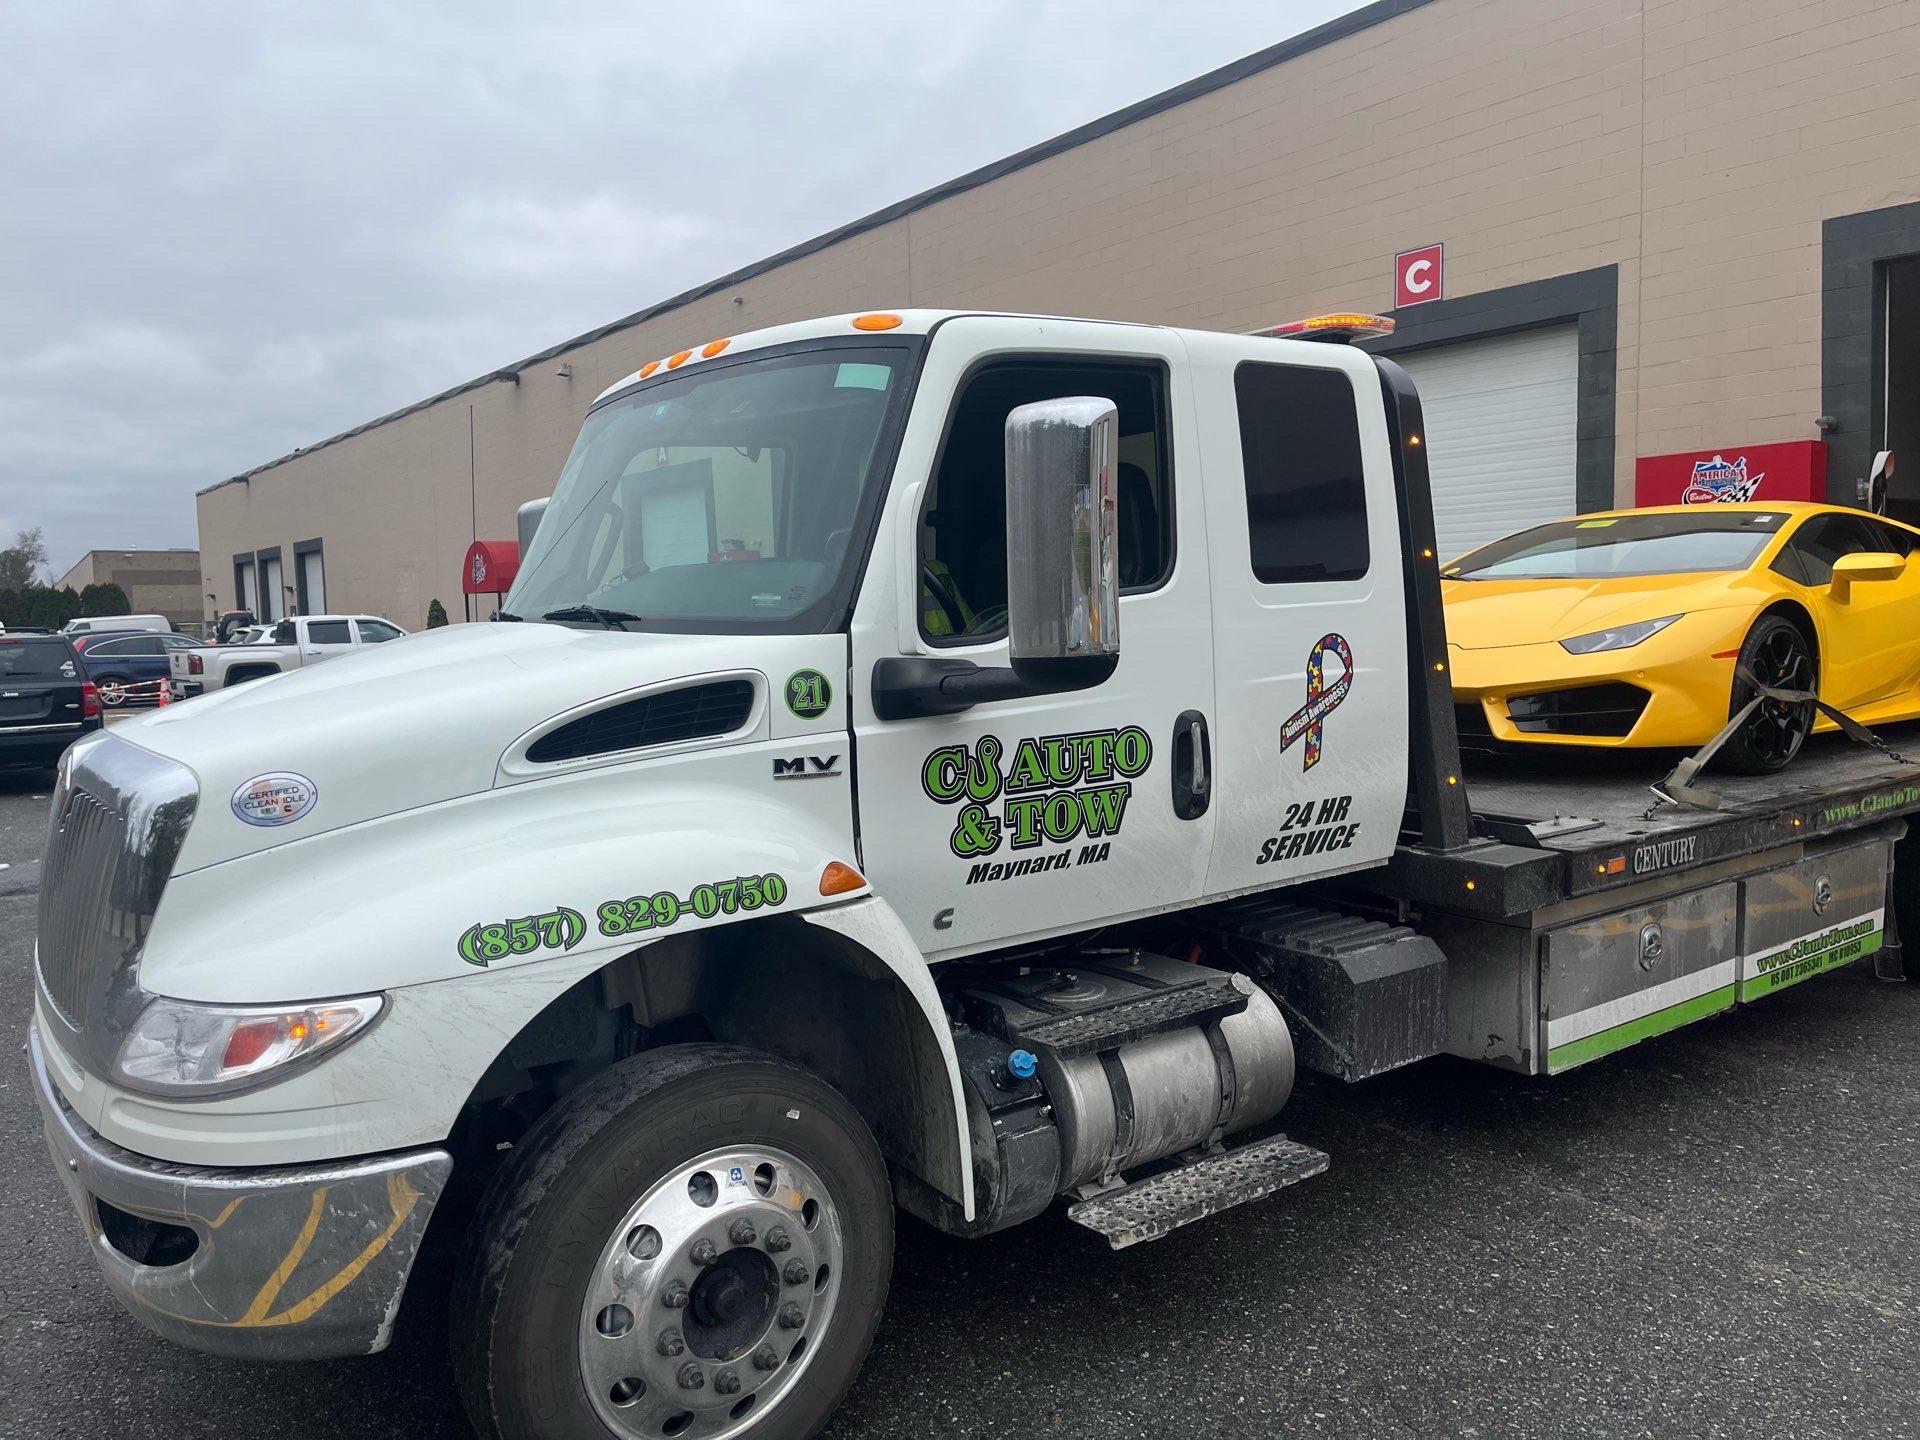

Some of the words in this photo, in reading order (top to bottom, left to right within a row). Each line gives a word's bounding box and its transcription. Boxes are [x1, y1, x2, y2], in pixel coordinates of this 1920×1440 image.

[1405, 260, 1432, 293] C
[1693, 467, 1746, 486] AMERICA'S
[1689, 493, 1713, 502] Boston
[791, 675, 827, 711] 21
[1284, 713, 1310, 739] Autism
[1308, 684, 1346, 720] Awareness
[773, 754, 840, 774] MV
[1004, 725, 1153, 795] AUTO
[243, 798, 279, 810] CLEAN
[282, 794, 306, 804] IDLE
[248, 787, 300, 800] CERTIFIED
[1823, 786, 1920, 822] www.CJautoTo
[950, 803, 1003, 859] &
[1004, 781, 1132, 850] TOW
[1279, 801, 1316, 831] 24
[1315, 796, 1352, 825] HR
[1256, 823, 1361, 865] SERVICE
[1633, 835, 1697, 875] CENTURY
[966, 849, 1071, 886] Maynard,
[1077, 842, 1111, 866] MA
[457, 906, 587, 967] (857)
[597, 873, 787, 937] 829-0750
[1770, 972, 1780, 986] US
[1781, 965, 1794, 984] DOT
